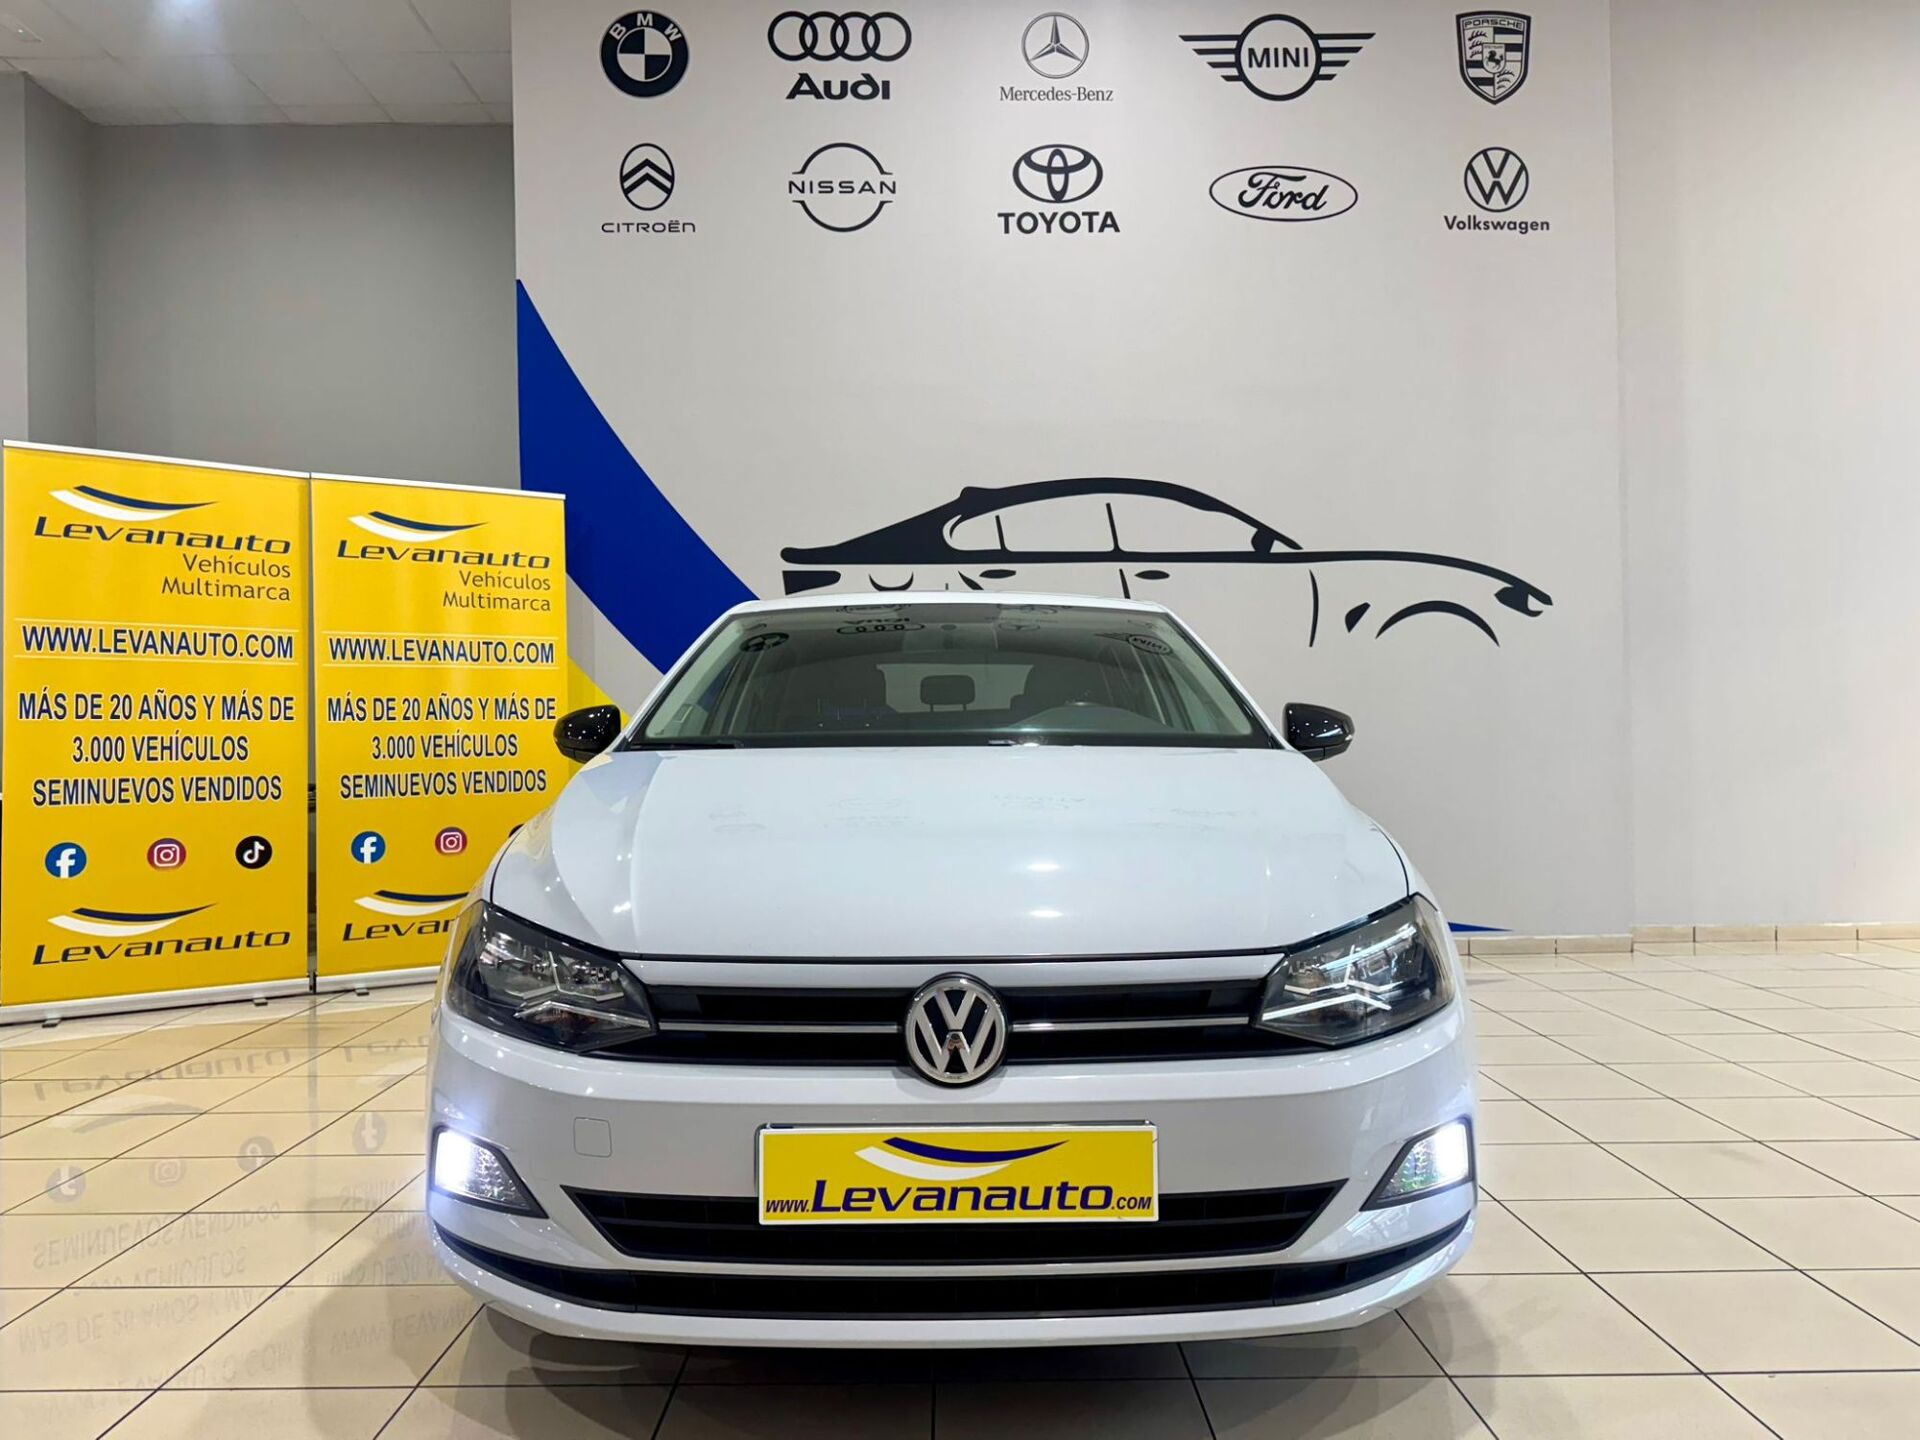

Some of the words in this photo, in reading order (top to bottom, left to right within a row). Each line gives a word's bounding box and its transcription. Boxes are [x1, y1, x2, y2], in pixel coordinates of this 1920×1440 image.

[608, 13, 682, 42] BMW
[1464, 18, 1523, 30] PORSCHE
[1247, 47, 1310, 71] MINI
[786, 73, 891, 101] Audi
[1000, 86, 1114, 102] Mercedes-Benz
[788, 180, 896, 195] NISSAN
[1238, 172, 1330, 211] Ford
[997, 212, 1120, 234] TOYOTA
[1444, 215, 1550, 235] Volkswagen
[34, 516, 291, 554] Levanauto
[183, 553, 291, 579] Vehículos
[337, 539, 550, 569] Levanauto
[161, 576, 291, 602] Multimarca
[459, 570, 551, 591] Vehículos
[443, 591, 551, 612] Multimarca
[22, 625, 294, 659] WWW.LEVANAUTO.COM
[329, 637, 554, 664] WWW.LEVANAUTO.COM
[18, 687, 67, 720] MÁS
[75, 693, 103, 720] DE
[110, 694, 132, 720] 20
[138, 689, 197, 720] AÑOS
[203, 695, 216, 720] Y
[222, 690, 264, 721] MÁS
[270, 696, 294, 721] DE
[327, 692, 367, 721] MÁS
[373, 697, 396, 721] DE
[402, 697, 421, 721] 20
[425, 693, 473, 720] AÑOS
[478, 697, 489, 720] Y
[494, 693, 529, 720] MÁS
[535, 697, 556, 720] DE
[72, 736, 125, 762] 3.000
[132, 730, 249, 762] VEHÍCULOS
[372, 735, 415, 759] 3.000
[421, 730, 518, 758] VEHÍCULOS
[33, 777, 174, 806] SEMINUEVOS
[181, 775, 282, 802] VENDIDOS
[340, 771, 457, 799] SEMINUEVOS
[463, 769, 547, 794] VENDIDOS
[32, 930, 291, 965] Levanauto
